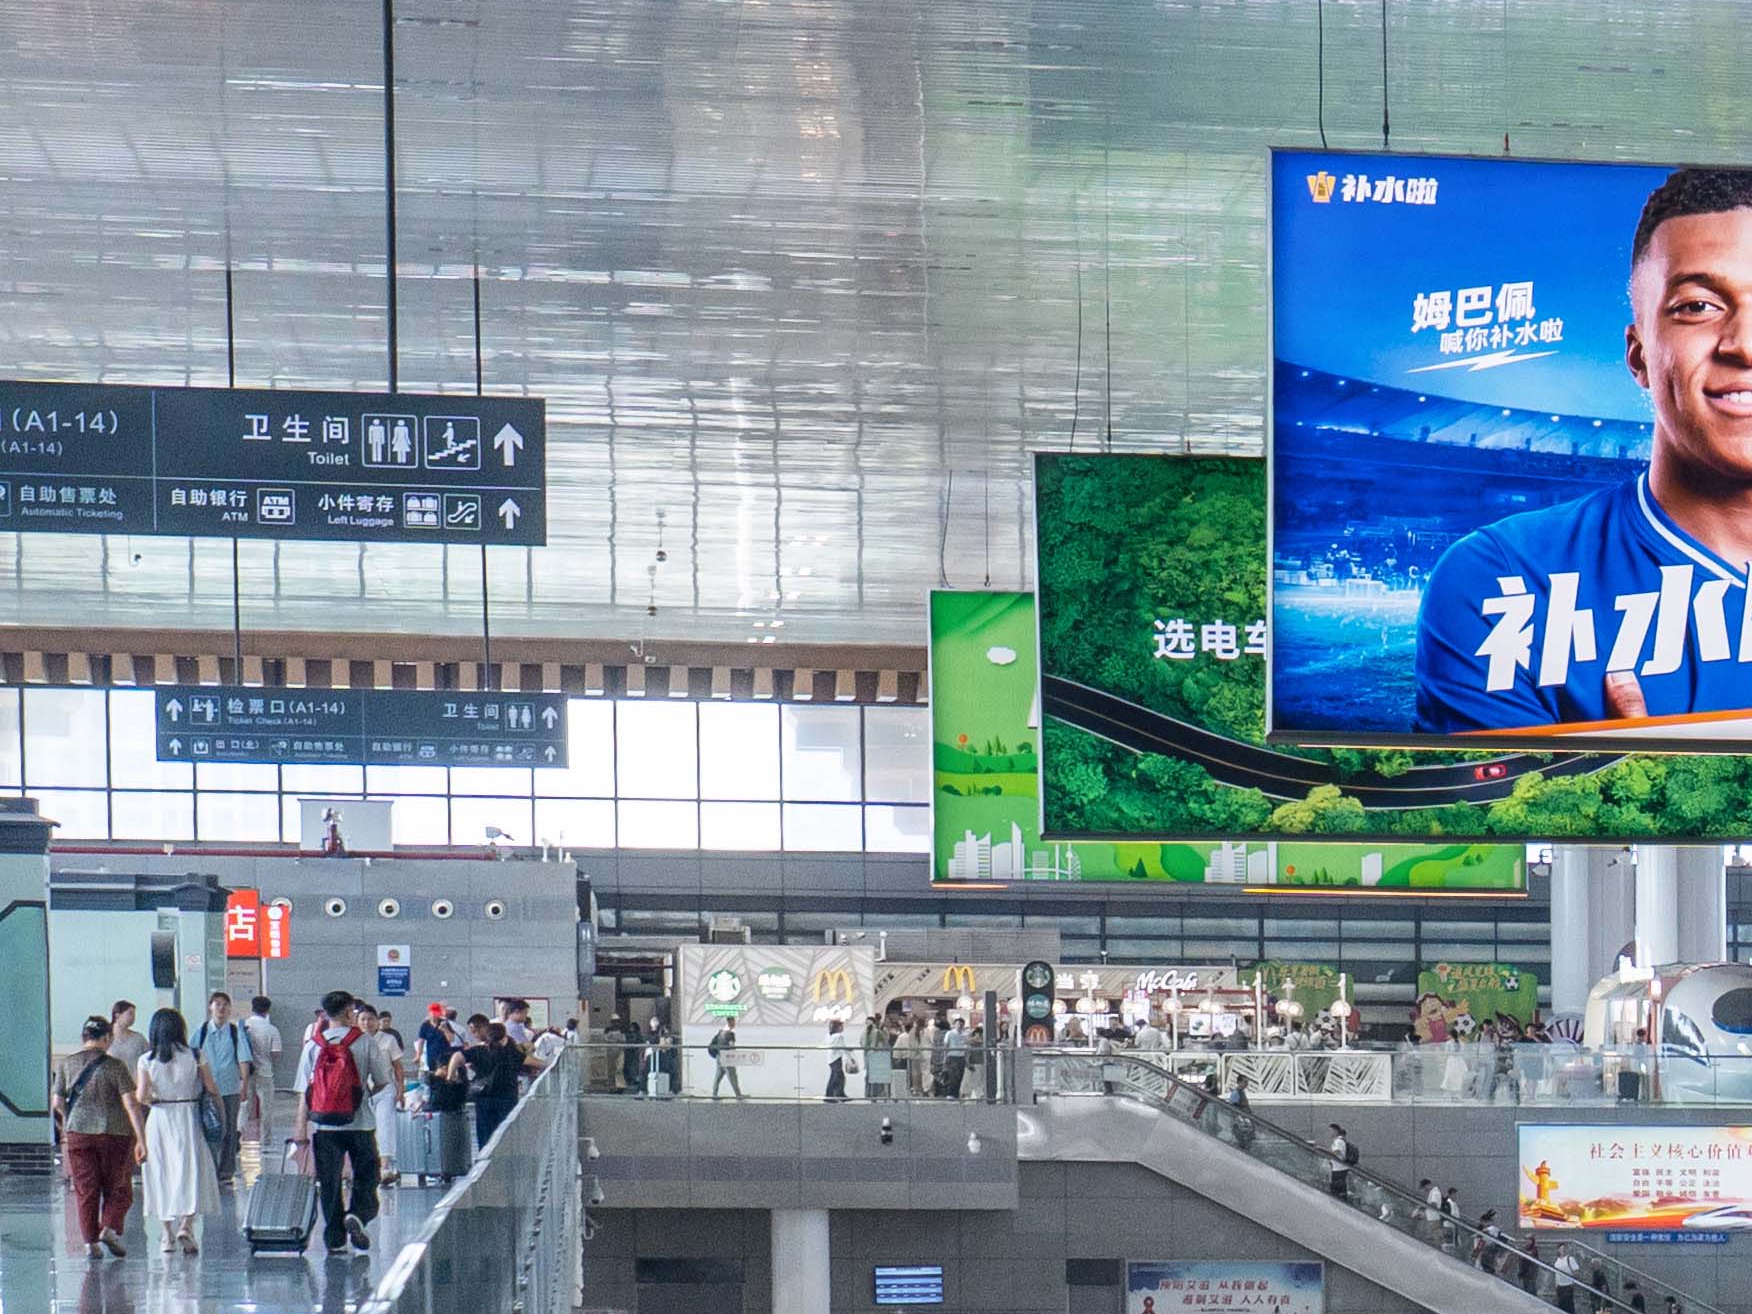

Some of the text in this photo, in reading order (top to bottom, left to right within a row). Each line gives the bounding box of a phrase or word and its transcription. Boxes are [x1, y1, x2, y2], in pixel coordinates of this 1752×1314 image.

[1341, 174, 1438, 205] 补水啦
[1411, 282, 1535, 333] 姆巴佩
[1440, 317, 1564, 356] 喊你补水啦
[12, 410, 119, 436] (A1-14)
[243, 413, 350, 444] 卫生间
[1, 440, 63, 456] (A1-14)
[307, 451, 350, 466] Toilet
[19, 485, 117, 506] 自助售票处
[171, 488, 248, 508] 自助银行
[262, 496, 290, 507] ATM
[318, 494, 395, 513] 小件寄存
[21, 507, 123, 521] Automatic Ticketing
[222, 512, 249, 522] ATM
[328, 515, 394, 527] Left Luggage
[443, 703, 500, 719] 卫生间
